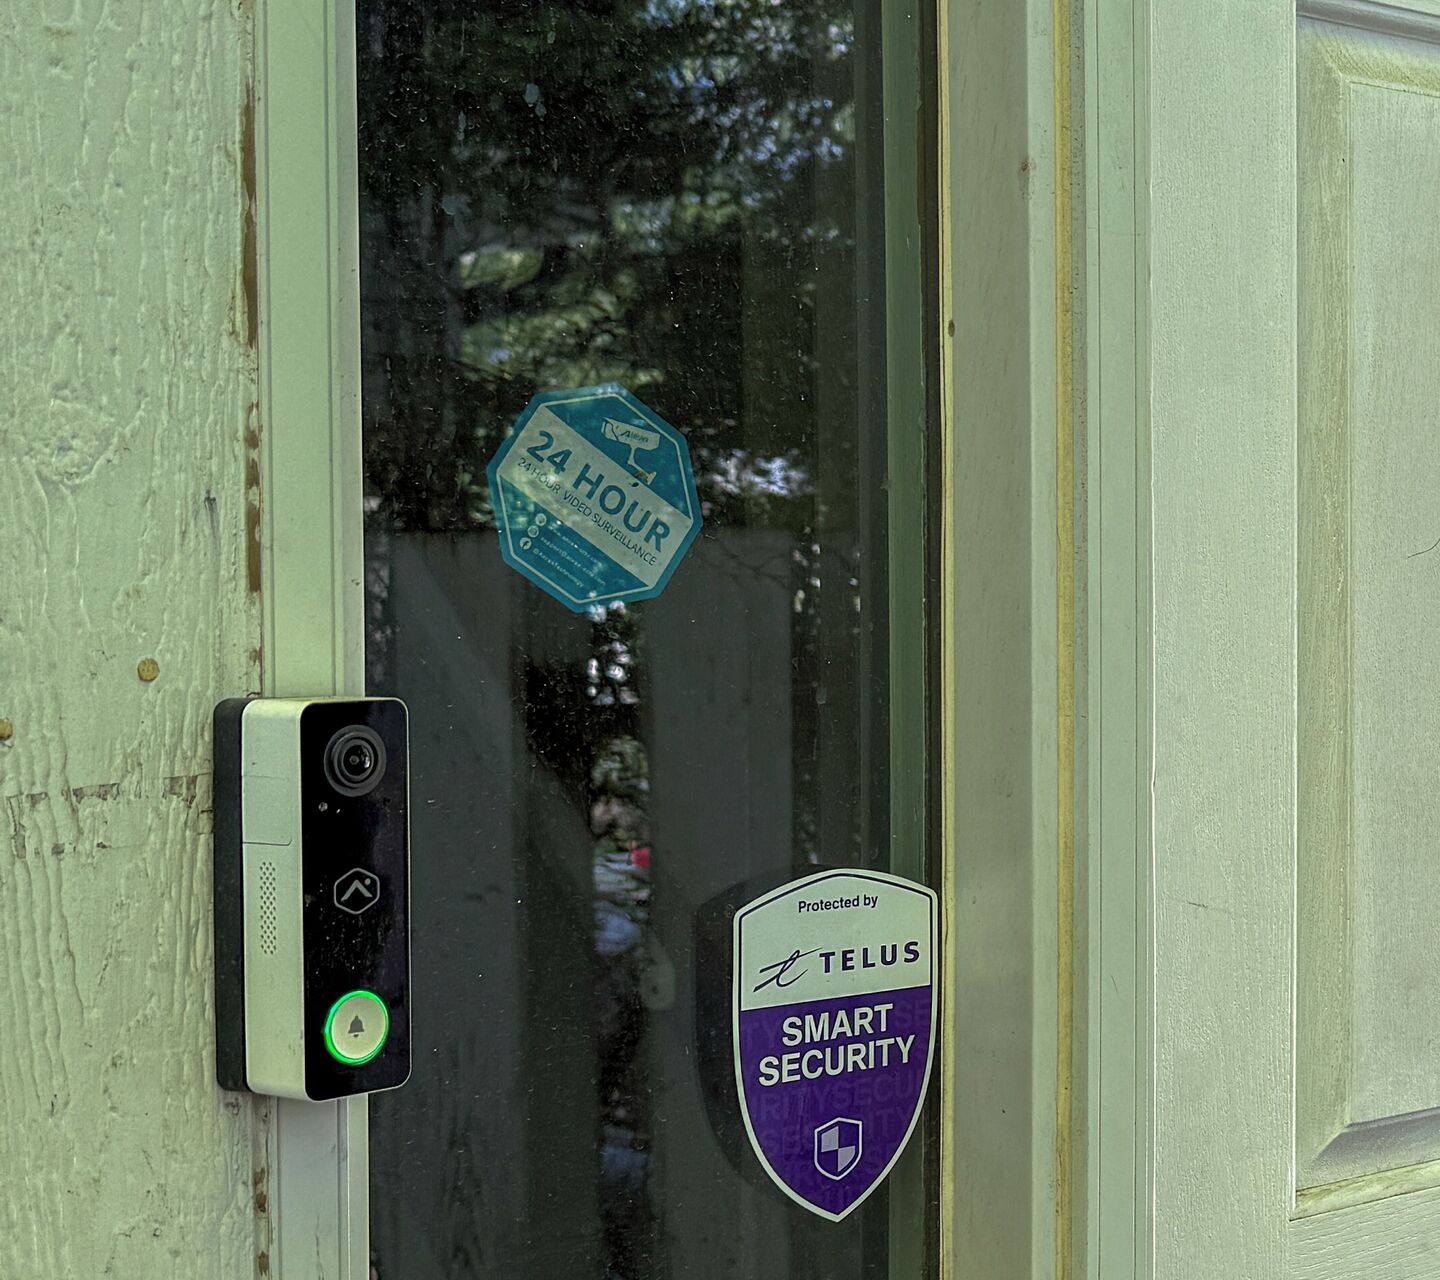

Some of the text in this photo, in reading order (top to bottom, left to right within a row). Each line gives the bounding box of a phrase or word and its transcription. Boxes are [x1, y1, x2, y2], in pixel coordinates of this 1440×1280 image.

[526, 431, 573, 475] 24
[572, 463, 671, 553] HOUR
[563, 489, 592, 517] VIDEO
[592, 512, 657, 566] SURVEILLANCE
[798, 894, 879, 914] Protected by
[818, 941, 921, 974] TELUS
[781, 1003, 894, 1047] SMART
[758, 1034, 916, 1087] SECURITY
